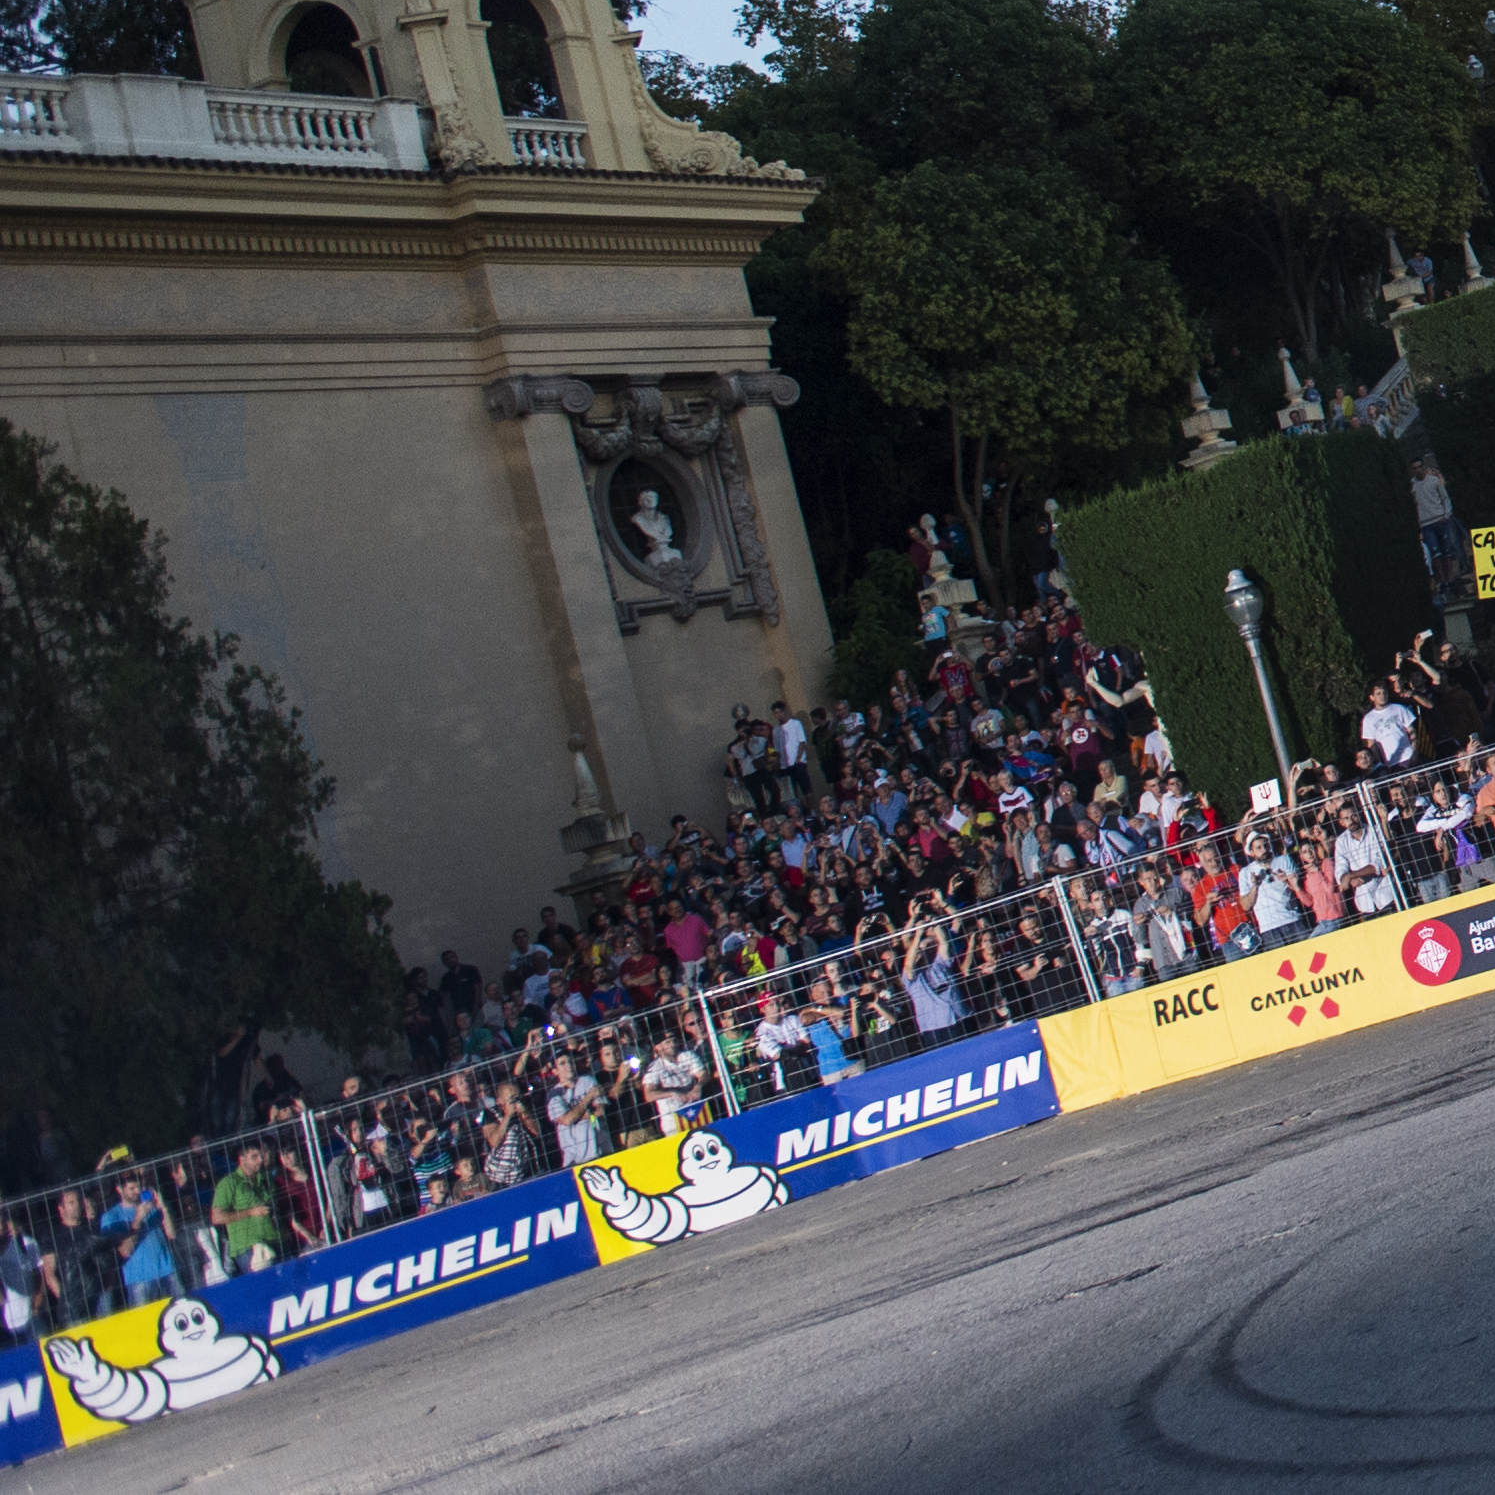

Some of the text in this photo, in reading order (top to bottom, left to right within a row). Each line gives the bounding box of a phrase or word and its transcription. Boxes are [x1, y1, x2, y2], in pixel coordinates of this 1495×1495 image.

[1153, 966, 1365, 1027] RACC CATALUNYA
[776, 1050, 1042, 1166] MICHELIN
[268, 1201, 580, 1335] MICHELIN
[0, 1375, 43, 1423] N
